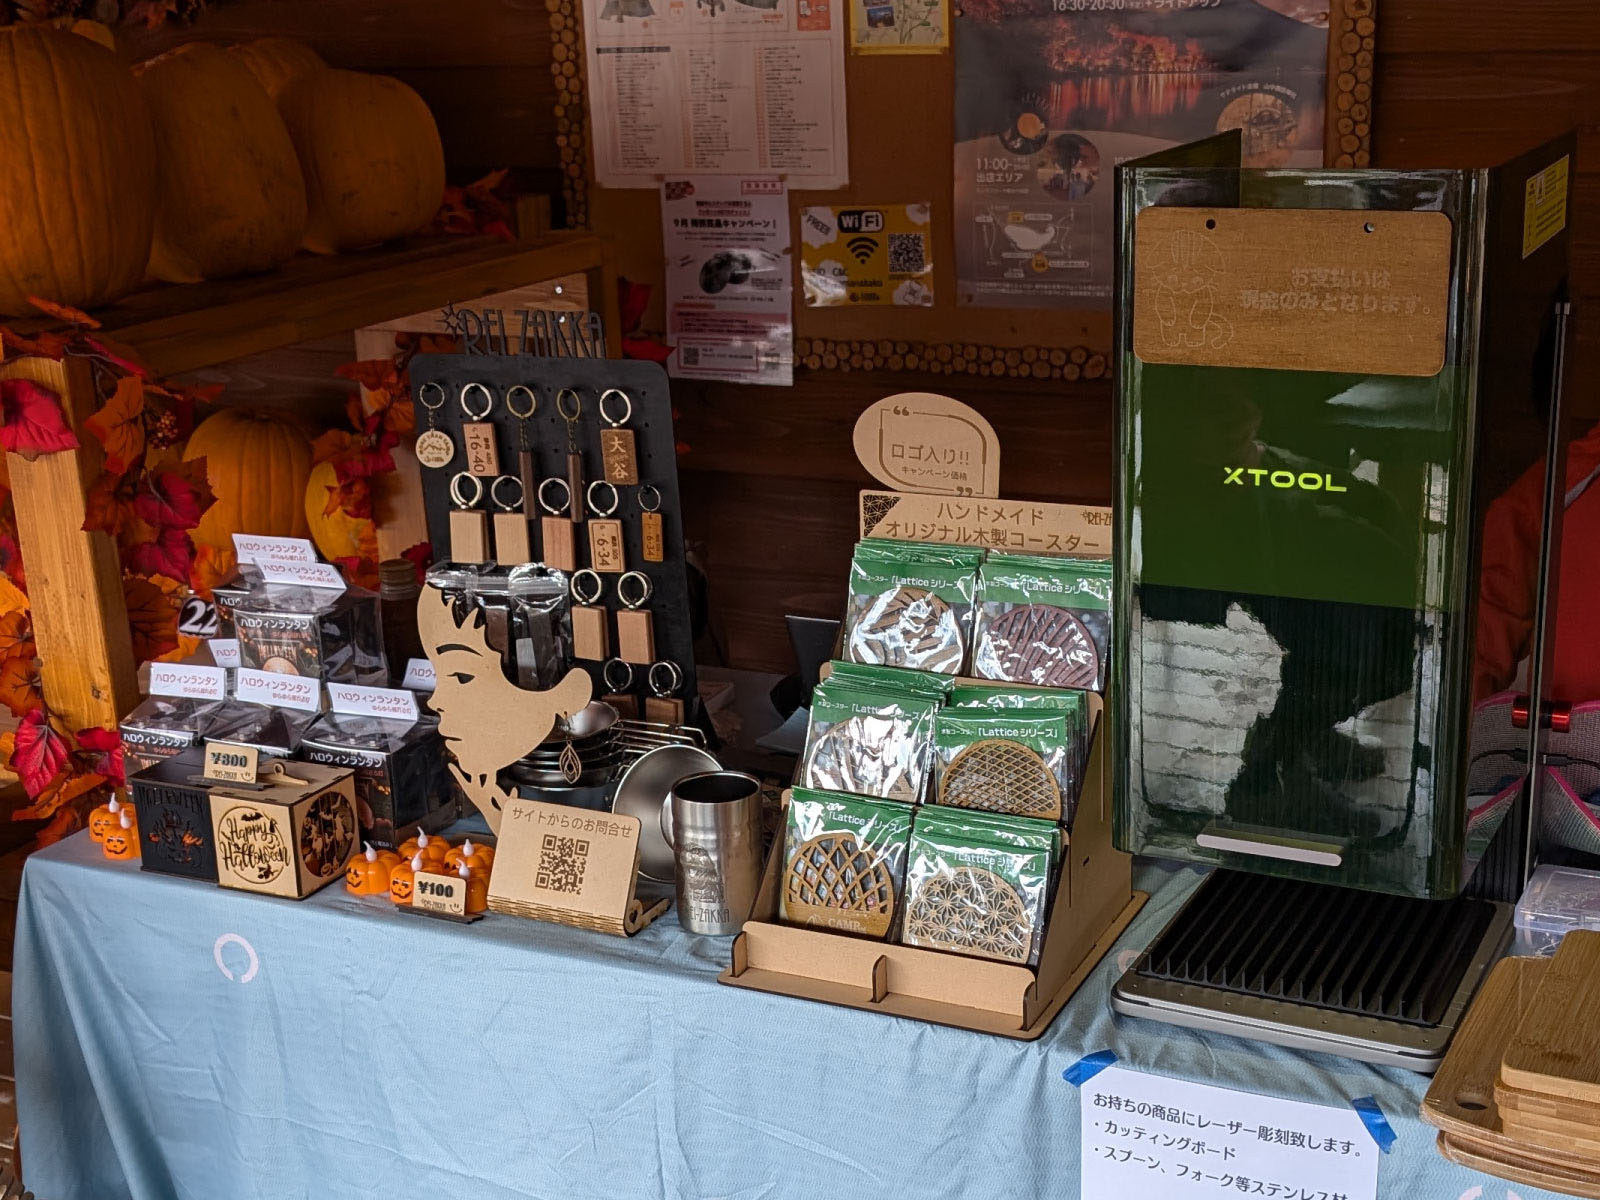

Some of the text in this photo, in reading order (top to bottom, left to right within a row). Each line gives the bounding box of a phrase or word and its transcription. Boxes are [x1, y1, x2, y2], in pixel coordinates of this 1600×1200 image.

[1223, 467, 1347, 492] XTOOL
[937, 502, 1044, 527] ハンドメイド
[885, 520, 1100, 552] オリジナル木製コースター
[240, 617, 310, 631] ハロウィンランタン
[155, 674, 218, 686] ハロウィンランタン
[241, 677, 311, 694] ハロウィンランタン
[337, 692, 409, 705] ハロウィンランタン
[123, 733, 189, 748] ハロウィンランタン
[310, 752, 382, 768] ハロウィンランタン
[226, 815, 272, 845] Happy
[512, 806, 633, 838] サイトからのお問合せ
[219, 839, 291, 872] Halloween
[418, 880, 454, 898] ¥100
[1093, 1092, 1361, 1159] お持ちの商品にレーザー彫刻致します。
